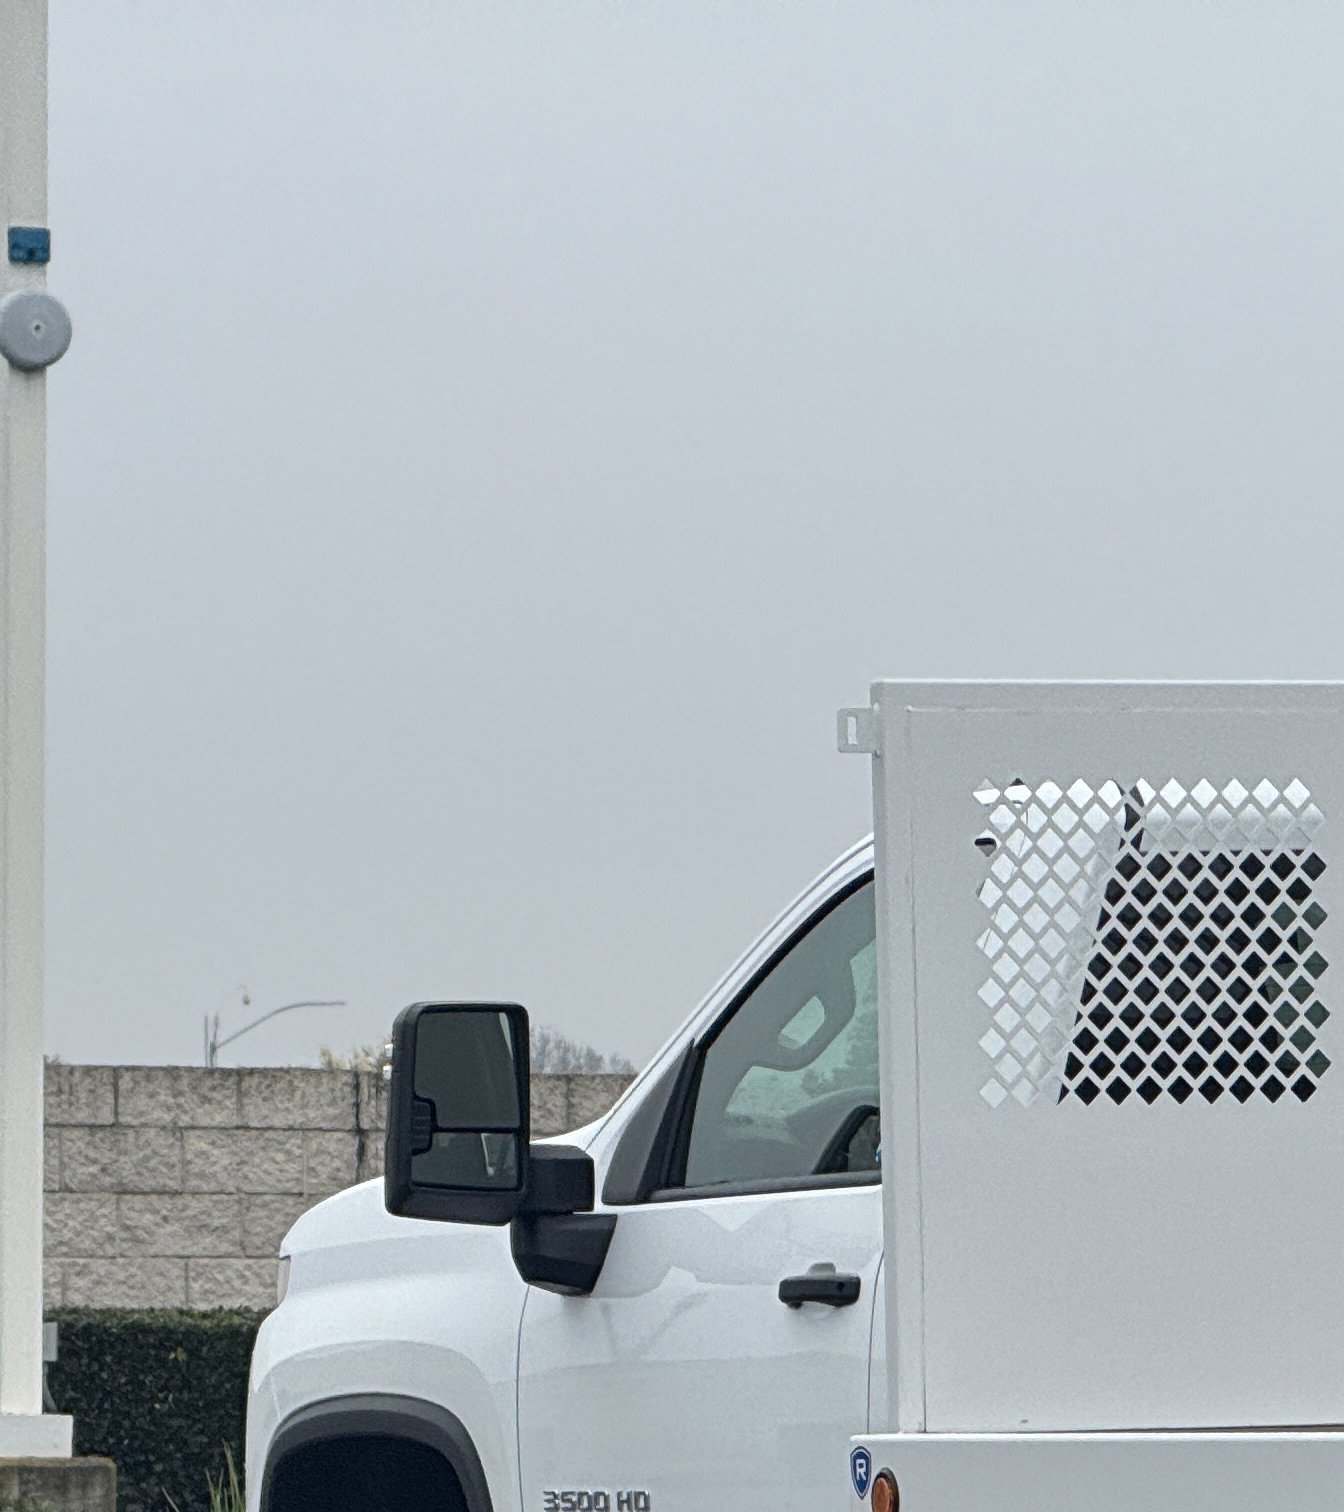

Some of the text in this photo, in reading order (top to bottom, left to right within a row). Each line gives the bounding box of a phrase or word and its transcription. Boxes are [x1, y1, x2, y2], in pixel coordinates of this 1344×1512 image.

[855, 1458, 867, 1481] R
[543, 1490, 651, 1512] 3500 HD
